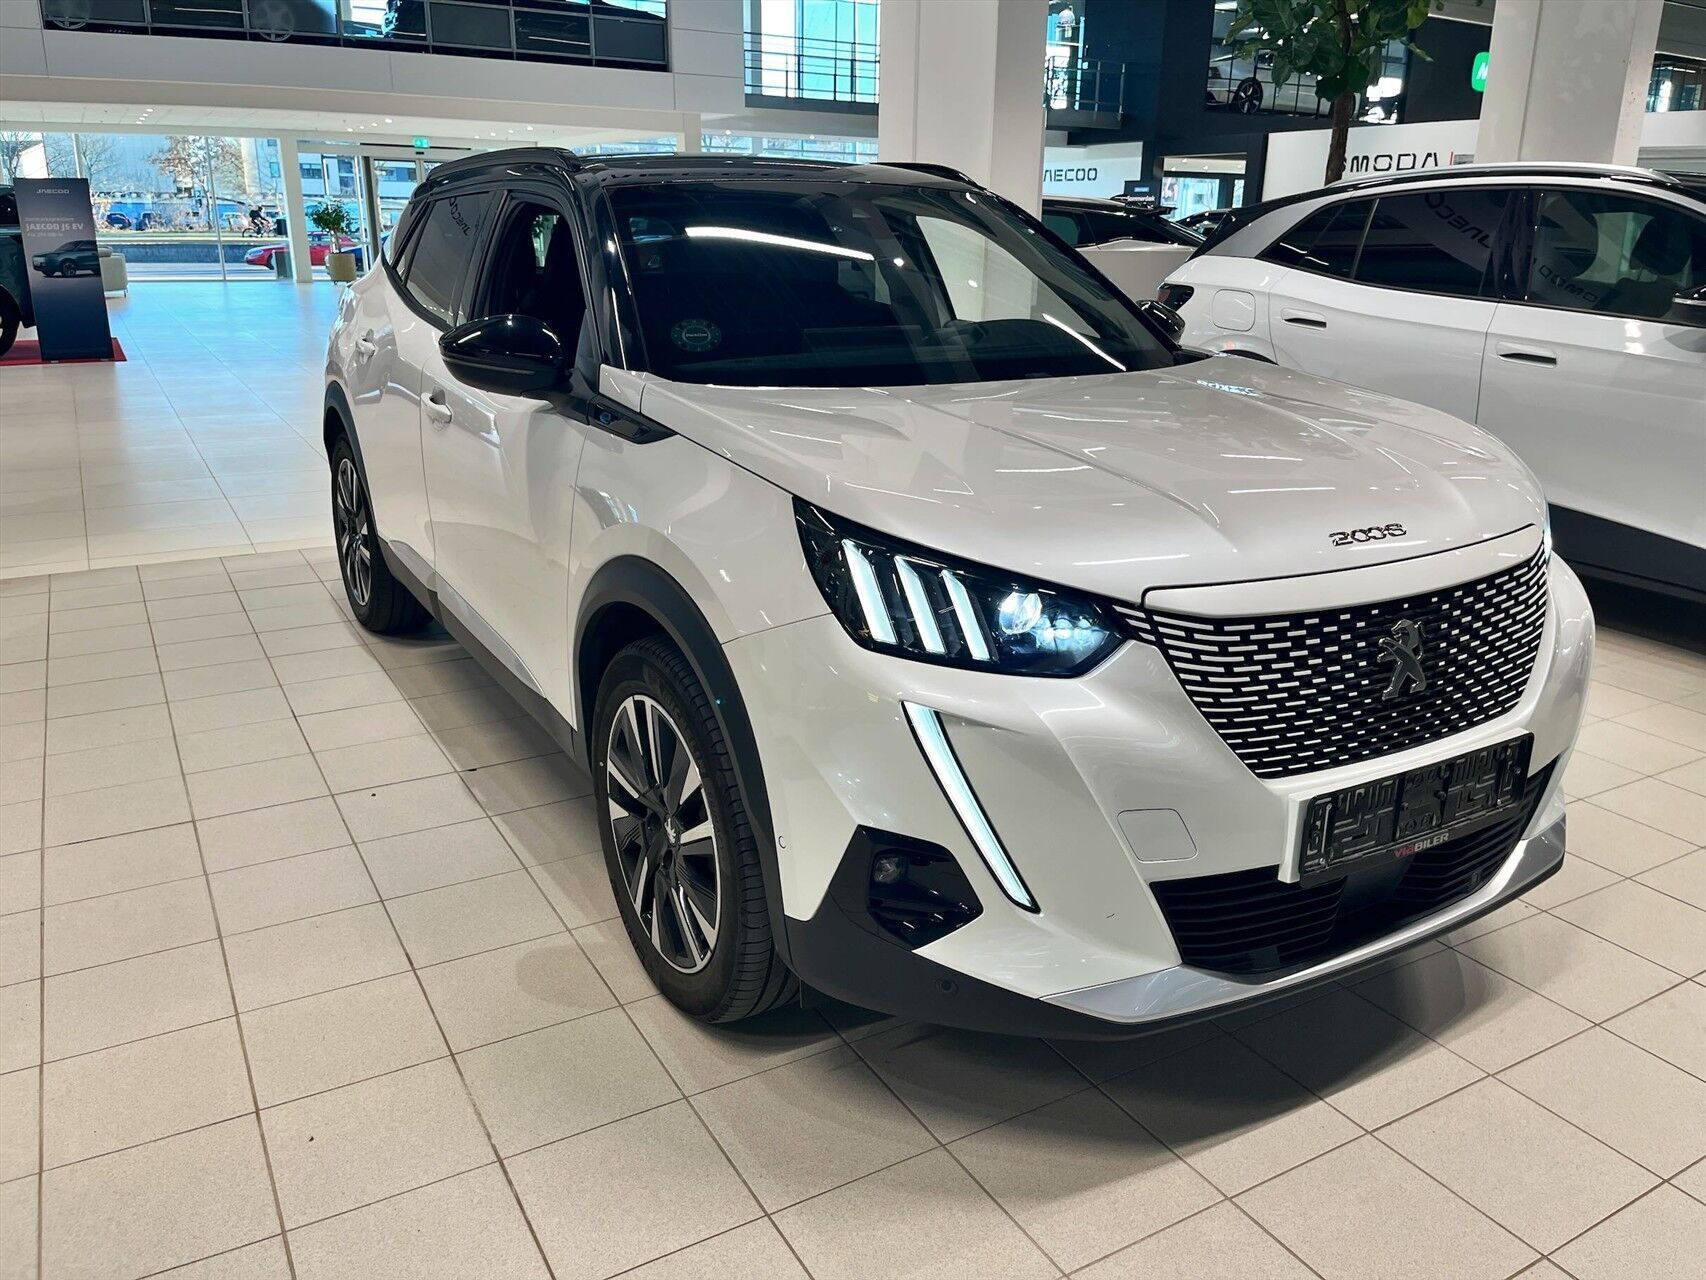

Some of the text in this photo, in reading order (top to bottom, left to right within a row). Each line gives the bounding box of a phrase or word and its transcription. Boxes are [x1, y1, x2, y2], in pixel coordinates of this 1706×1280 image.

[1349, 152, 1439, 172] MODA
[1043, 168, 1098, 182] AECOO
[1328, 523, 1407, 547] 2008
